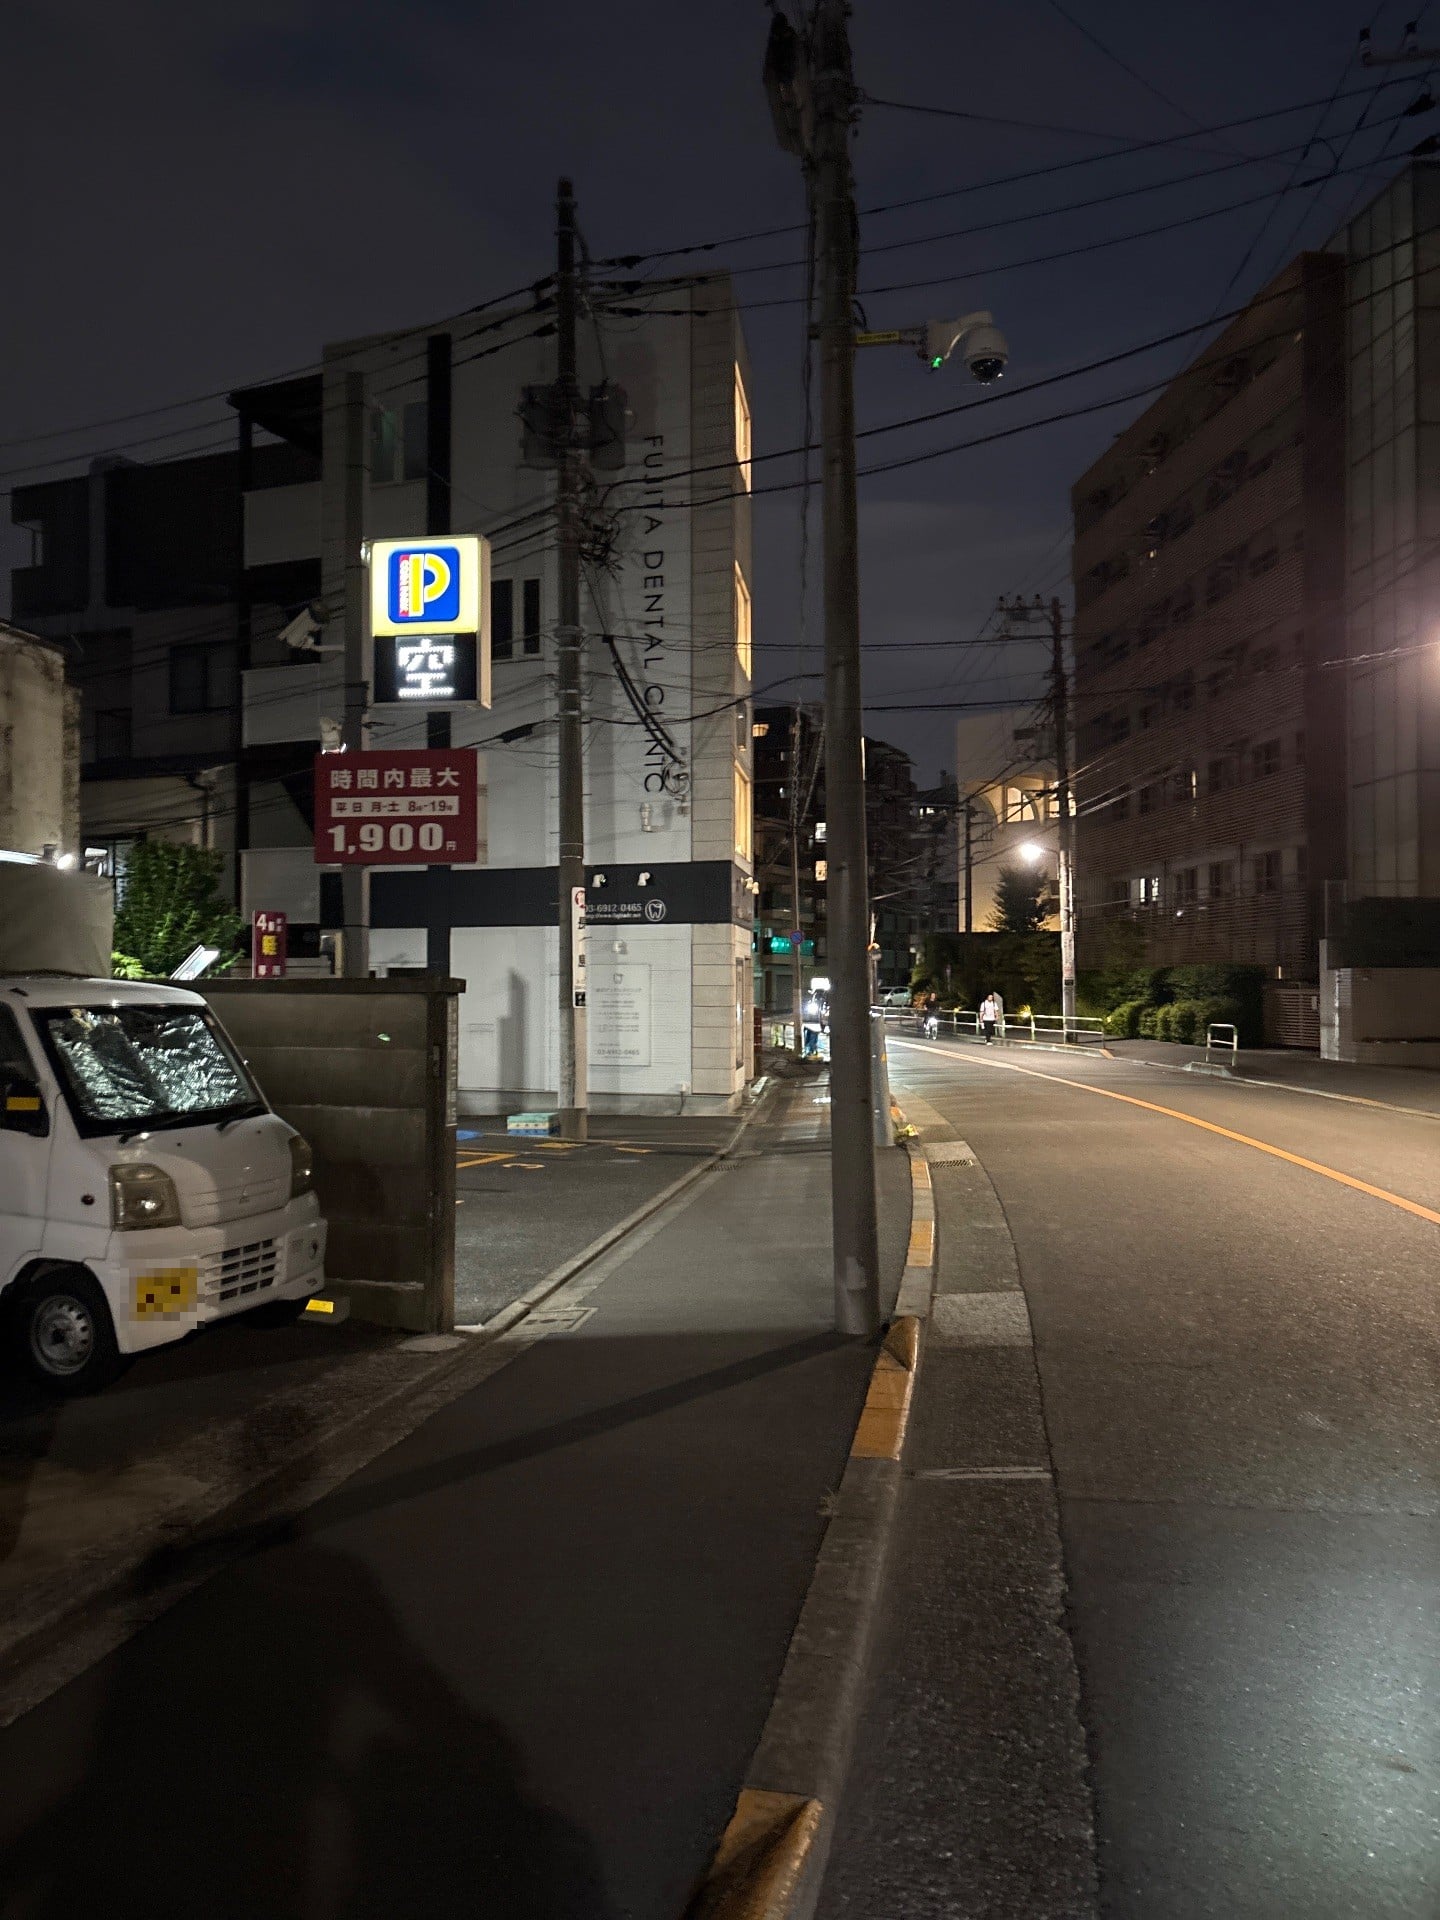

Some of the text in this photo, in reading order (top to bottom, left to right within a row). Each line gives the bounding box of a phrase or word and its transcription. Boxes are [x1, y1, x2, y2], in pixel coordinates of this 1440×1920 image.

[644, 550, 664, 669] DENTAL
[398, 638, 454, 698] 空
[644, 685, 665, 793] CLINIC
[330, 768, 460, 789] 時間内最大
[335, 802, 362, 813] 平日
